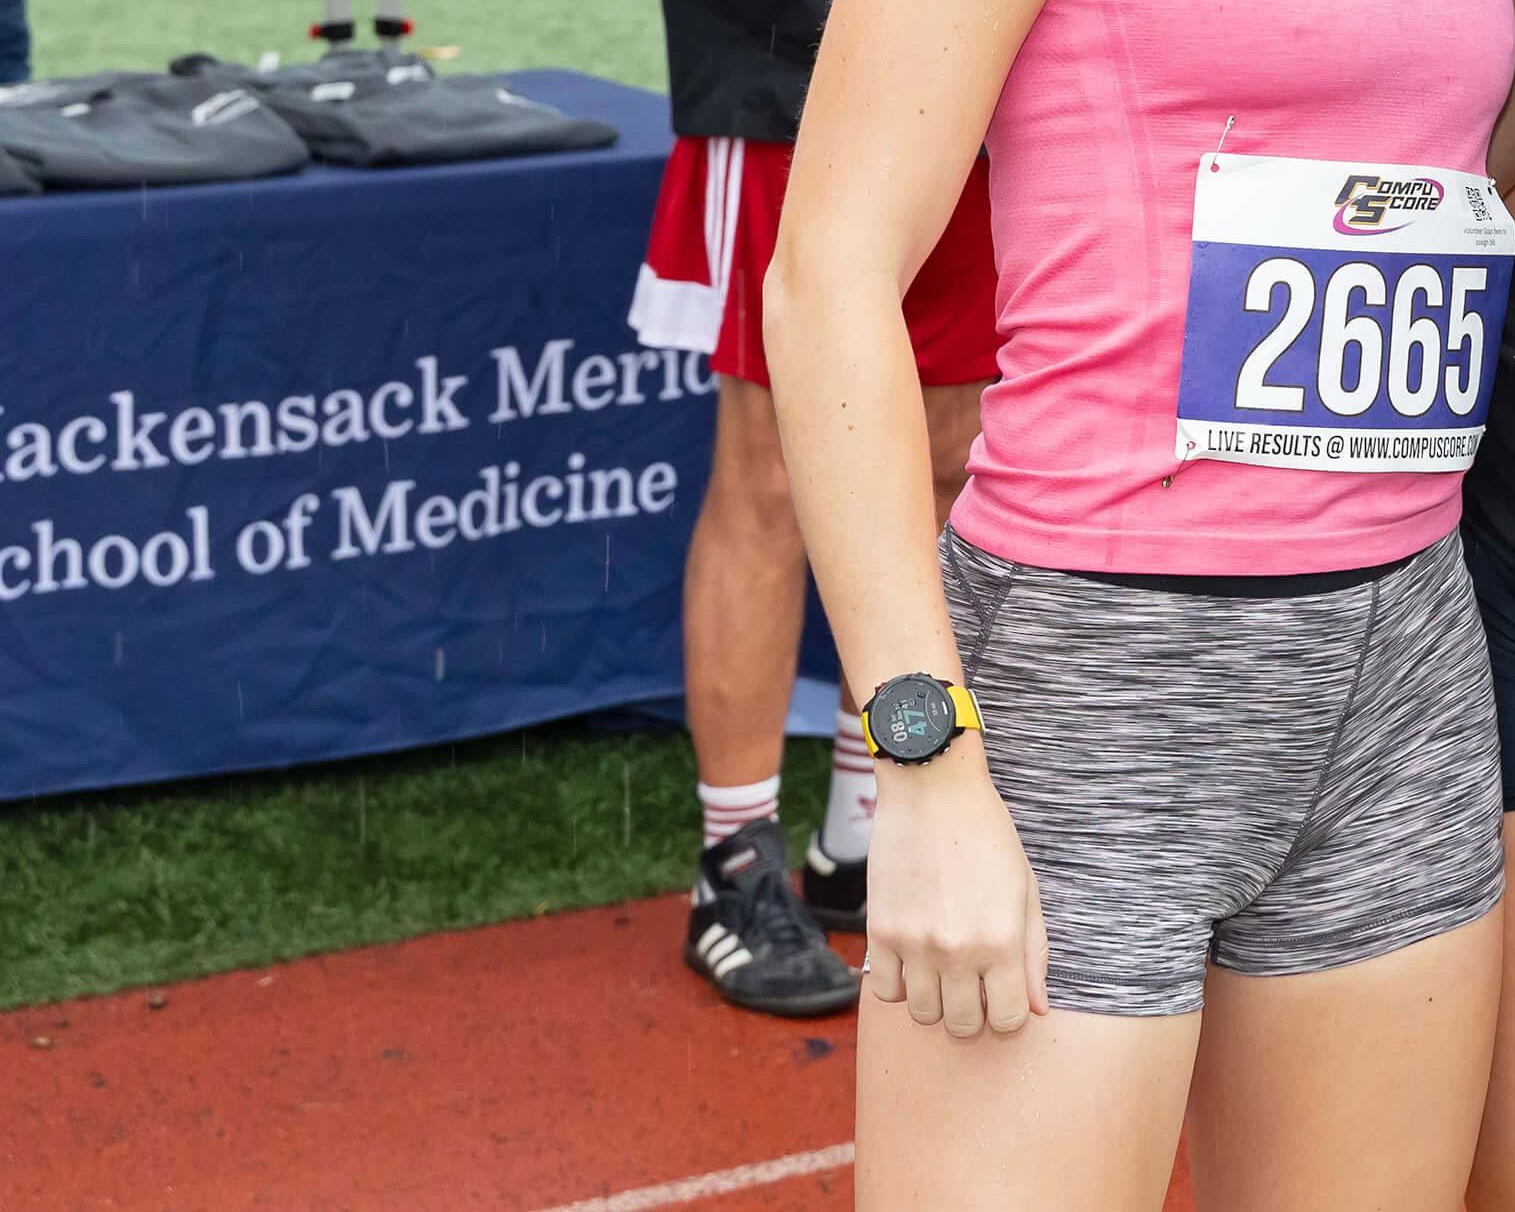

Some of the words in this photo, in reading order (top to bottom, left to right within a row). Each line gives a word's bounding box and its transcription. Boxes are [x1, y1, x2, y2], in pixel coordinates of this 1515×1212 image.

[1348, 194, 1440, 226] SCORE
[1234, 256, 1489, 417] 2665
[0, 357, 469, 482] ackensack
[1207, 429, 1246, 453] LIVE
[1249, 432, 1321, 457] RESULTS
[1326, 435, 1345, 459] @
[236, 493, 319, 575] of
[330, 452, 678, 561] Medicine
